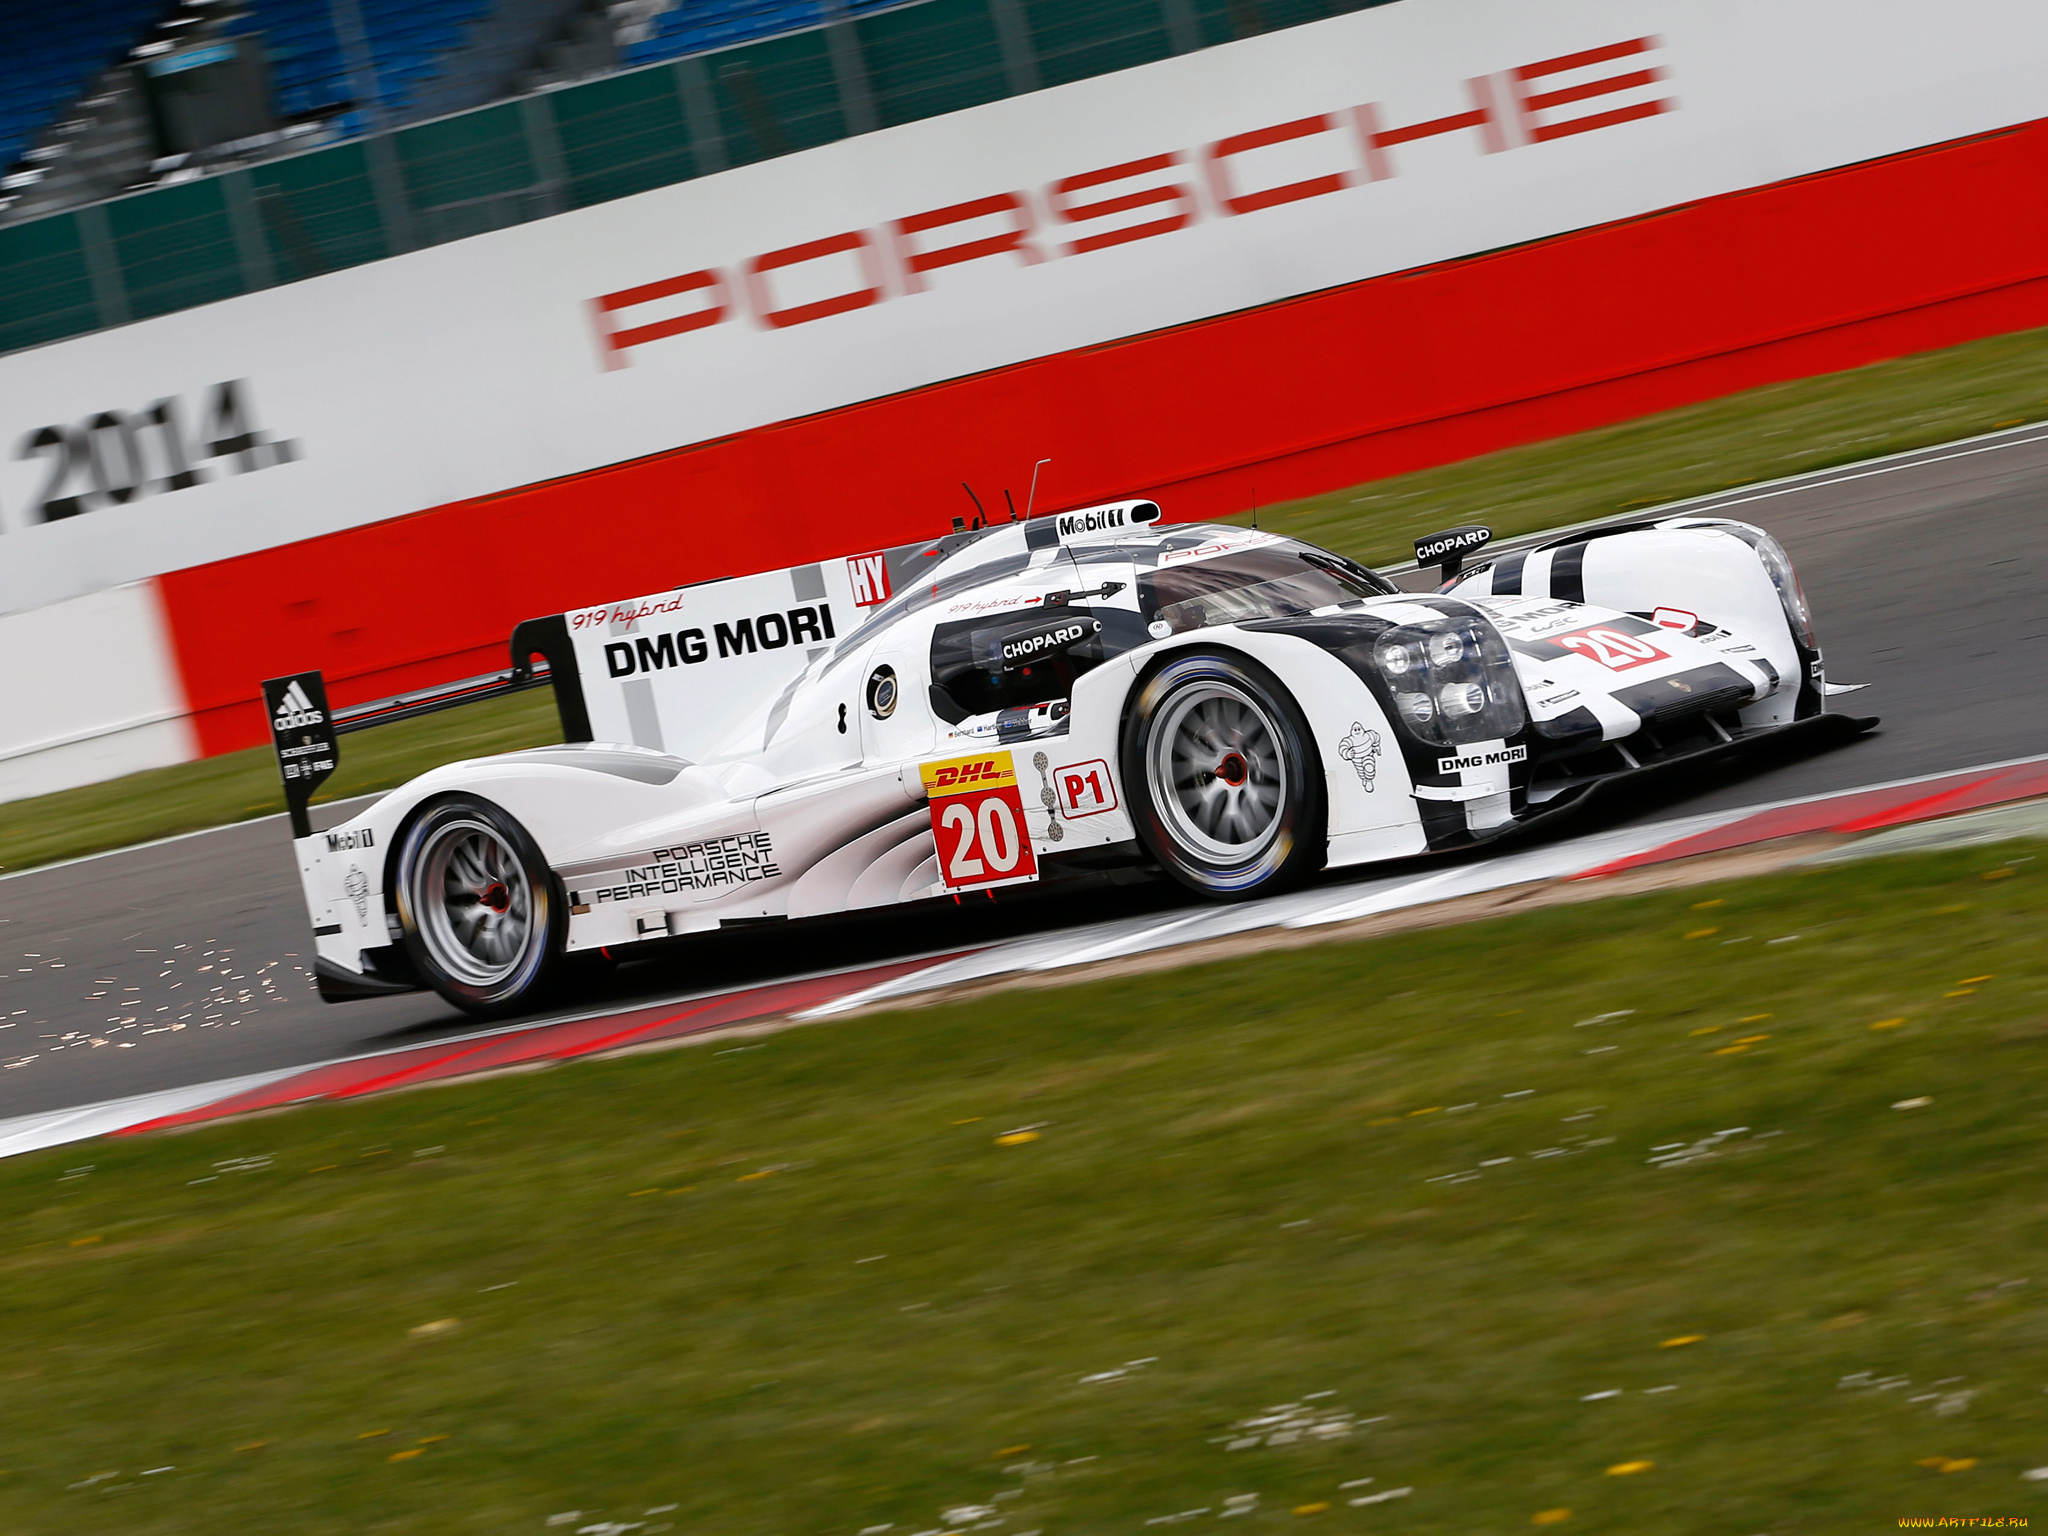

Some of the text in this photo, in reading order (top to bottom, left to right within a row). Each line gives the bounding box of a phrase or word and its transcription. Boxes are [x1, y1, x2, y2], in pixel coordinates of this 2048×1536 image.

[580, 34, 1683, 372] PORSCHE
[14, 378, 302, 526] 2014.
[1059, 508, 1125, 536] Mobil 1
[1416, 529, 1490, 559] CHOPARD
[847, 555, 886, 603] HY
[572, 593, 684, 630] 919 hybrid
[948, 595, 1022, 615] 919 hybrid
[1508, 602, 1588, 622] MOR
[603, 603, 836, 679] DMG MORI
[1003, 624, 1083, 659] CHOPARD
[1561, 628, 1657, 670] 20
[273, 709, 324, 731] adidas
[935, 760, 1002, 788] DHL
[1442, 747, 1525, 771] DMG MORI
[1063, 770, 1106, 809] P1
[326, 830, 361, 853] Mobil
[653, 832, 772, 863] PORSCHE
[941, 797, 1019, 879] 20
[596, 863, 783, 903] PERFORMANCE
[625, 848, 773, 883] INTELLIGENT
